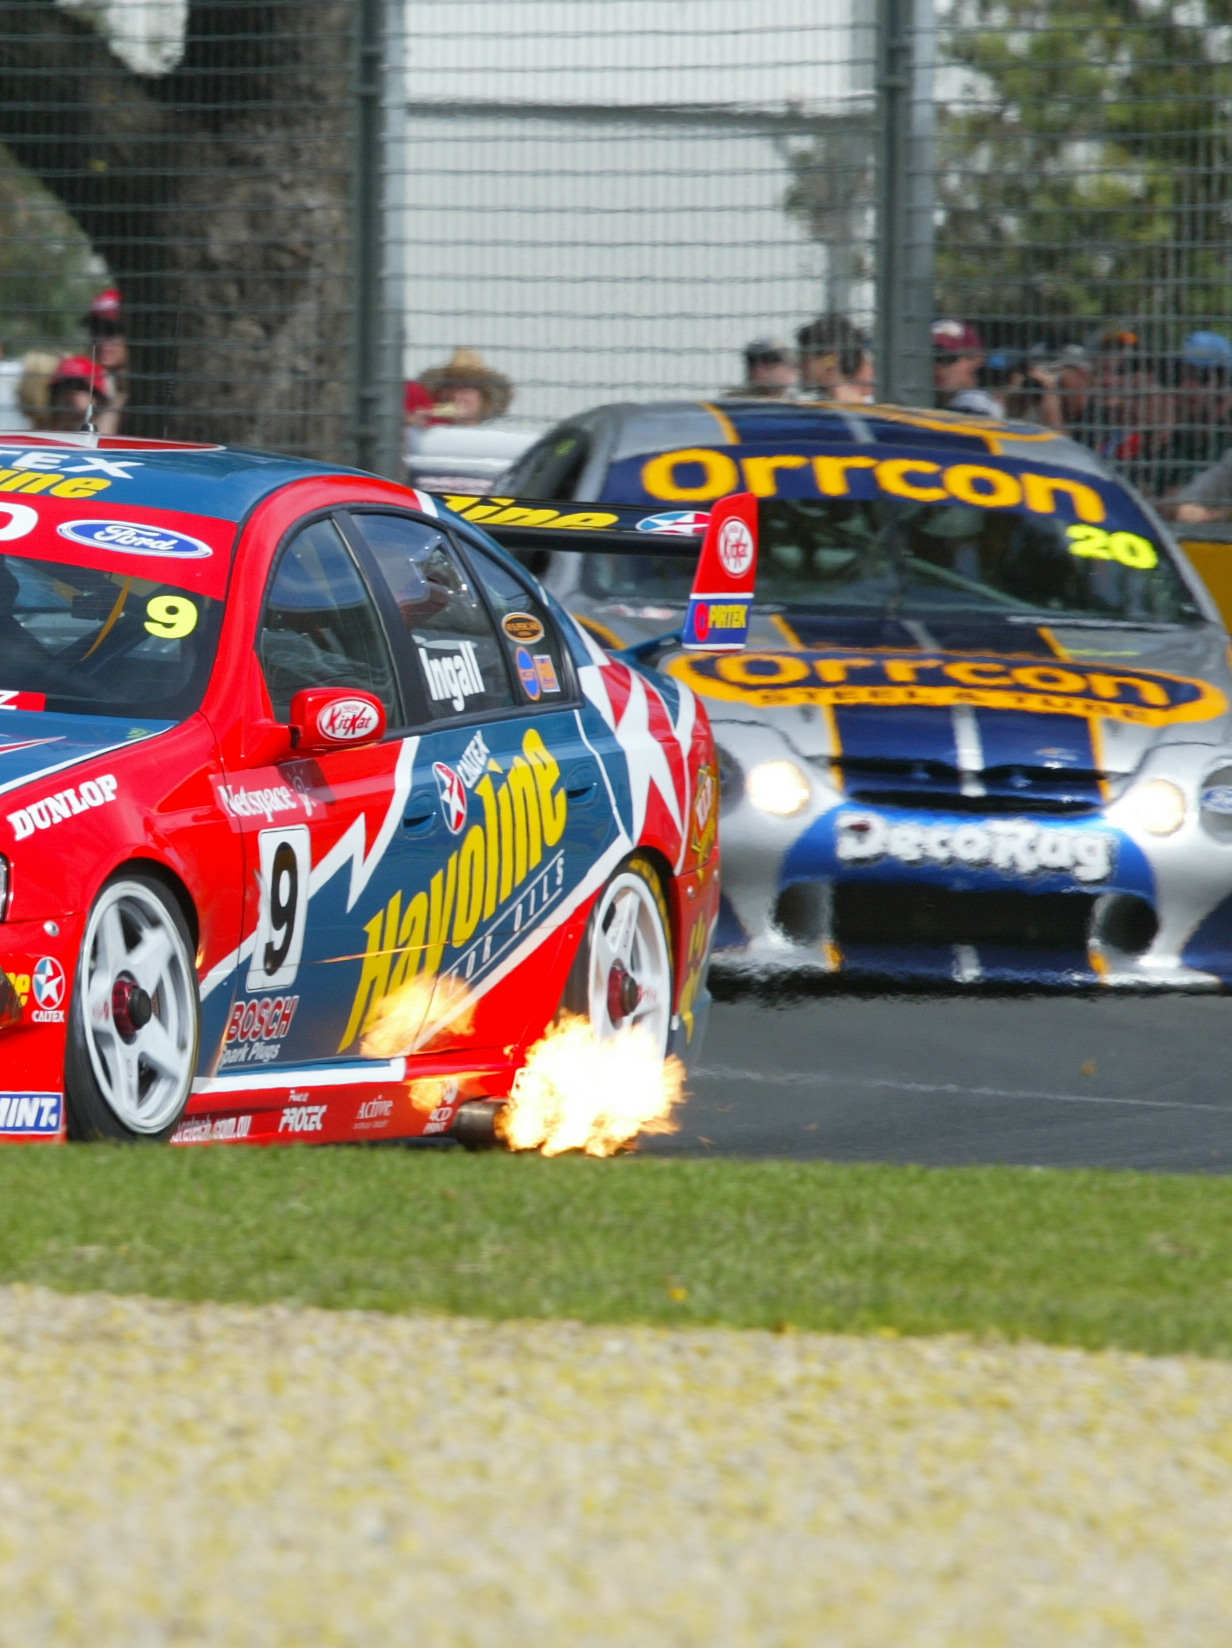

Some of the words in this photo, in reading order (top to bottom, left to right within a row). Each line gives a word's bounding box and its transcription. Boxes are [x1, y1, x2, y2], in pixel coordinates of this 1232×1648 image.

[641, 448, 1107, 523] Orrcon
[442, 495, 619, 528] line
[93, 524, 177, 552] Ford
[1065, 523, 1158, 569] 20
[144, 595, 199, 639] 9
[418, 640, 486, 712] Ingall
[713, 653, 1170, 706] Orrcon
[325, 706, 372, 737] KitKat
[457, 730, 490, 788] CALTEX
[6, 772, 118, 842] DUNLOP
[217, 784, 297, 822] Netspace
[835, 811, 1118, 883] DecoRug
[264, 841, 299, 976] 9
[336, 728, 567, 1055] Havoline
[31, 1010, 65, 1023] CALTEX
[224, 995, 300, 1044] BOSCH
